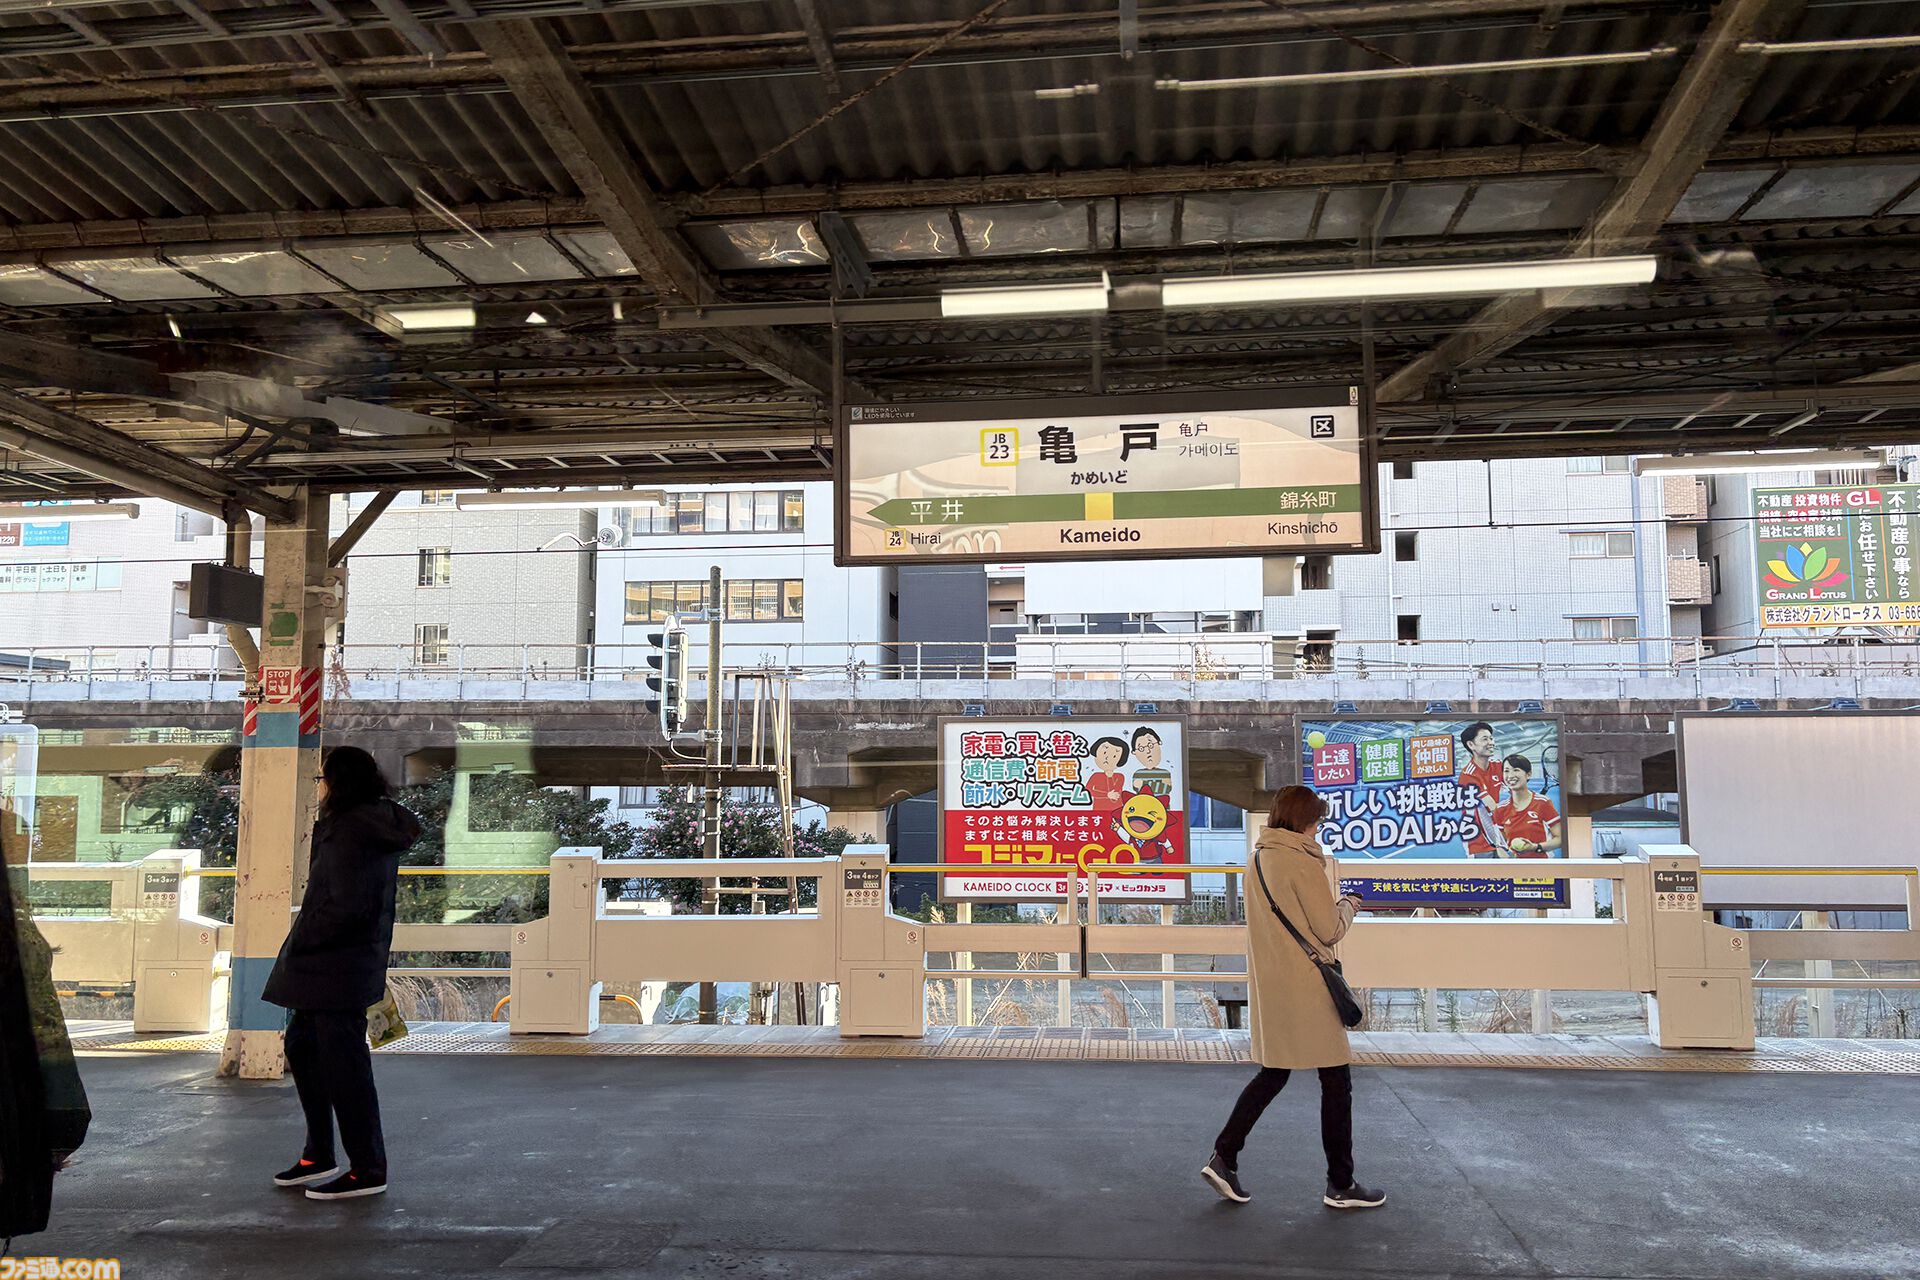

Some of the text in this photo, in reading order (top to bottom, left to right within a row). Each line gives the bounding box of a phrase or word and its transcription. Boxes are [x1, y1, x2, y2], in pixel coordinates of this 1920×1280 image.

[1312, 417, 1333, 437] 区
[993, 433, 1006, 443] JB
[1038, 422, 1160, 464] 亀戸
[989, 445, 1010, 460] 23
[1179, 442, 1239, 458] 가메이도
[1071, 470, 1128, 485] かめいど
[1280, 491, 1337, 509] 錦糸町
[910, 499, 964, 523] 平井
[1060, 527, 1141, 544] Kameido
[1268, 521, 1338, 535] Kinshichō
[889, 538, 902, 546] 24
[910, 532, 942, 545] Hirai
[1887, 490, 1912, 600] 不動産の事なら
[1766, 588, 1847, 600] GRAND LOTUS
[267, 670, 290, 679] STOP
[963, 732, 1089, 757] 家電の買い替え
[1365, 742, 1399, 760] 健康
[1317, 749, 1350, 767] 上達
[1414, 748, 1449, 764] 仲間
[963, 758, 1081, 782] 通信費・節電
[1318, 768, 1351, 781] したい
[1366, 761, 1400, 778] 促進
[1417, 764, 1448, 775] が欲しい
[963, 782, 1092, 806] 節水・リフォーム
[964, 815, 1104, 827] そのお悩み解決します
[964, 829, 1105, 842] まずはご相談ください
[963, 882, 1012, 892] KAMEIDO
[1014, 882, 1052, 892] CLOCK
